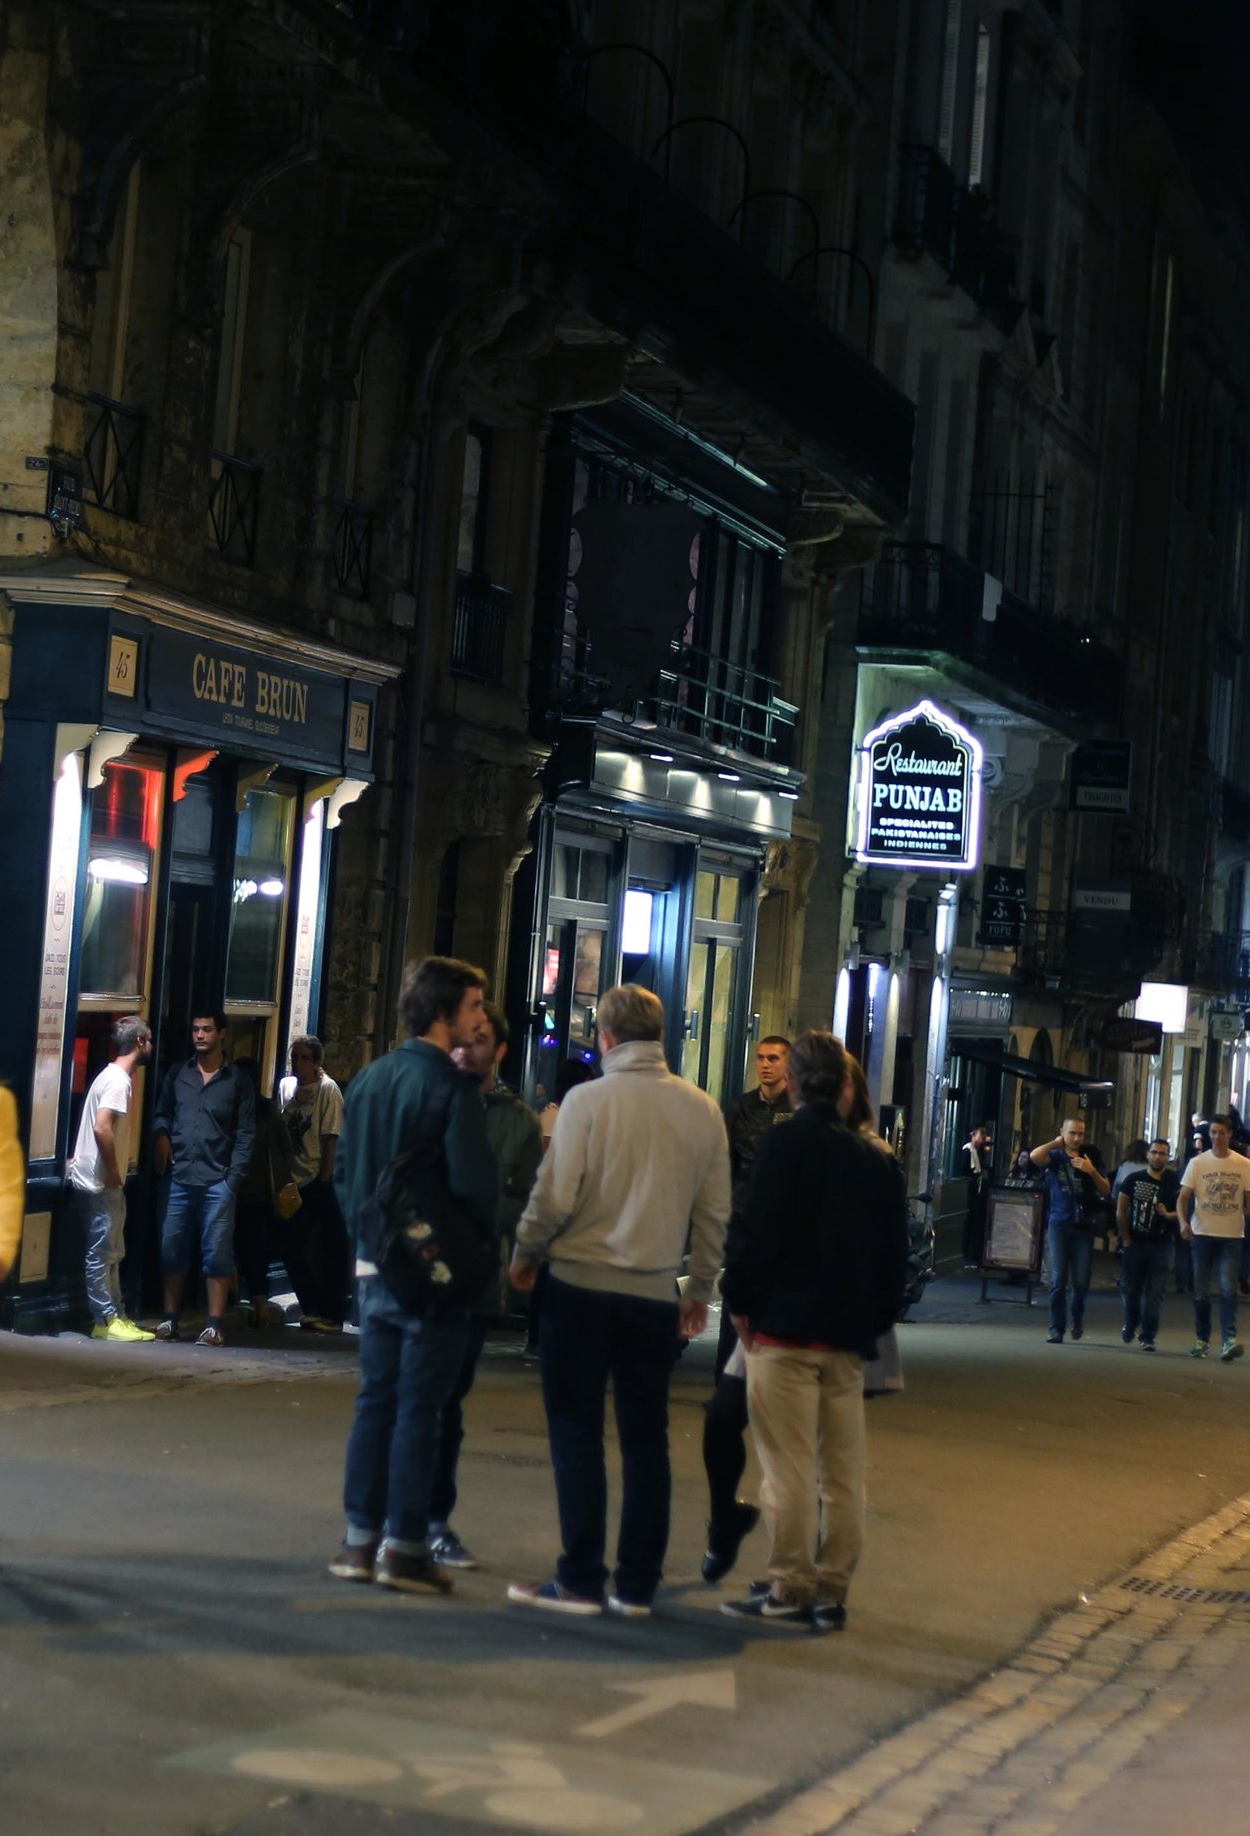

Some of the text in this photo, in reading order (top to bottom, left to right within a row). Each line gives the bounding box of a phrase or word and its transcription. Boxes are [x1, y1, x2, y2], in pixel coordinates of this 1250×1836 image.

[115, 651, 131, 679] 45
[192, 652, 309, 725] CAFE BRUN
[354, 714, 365, 738] 45
[873, 742, 963, 777] Restaurant
[873, 783, 962, 813] PUNJAB
[871, 828, 961, 841] PAKISTANAISES
[879, 817, 954, 830] SPECIALITES
[883, 839, 947, 851] INDIENNES
[1083, 894, 1119, 906] VENDU
